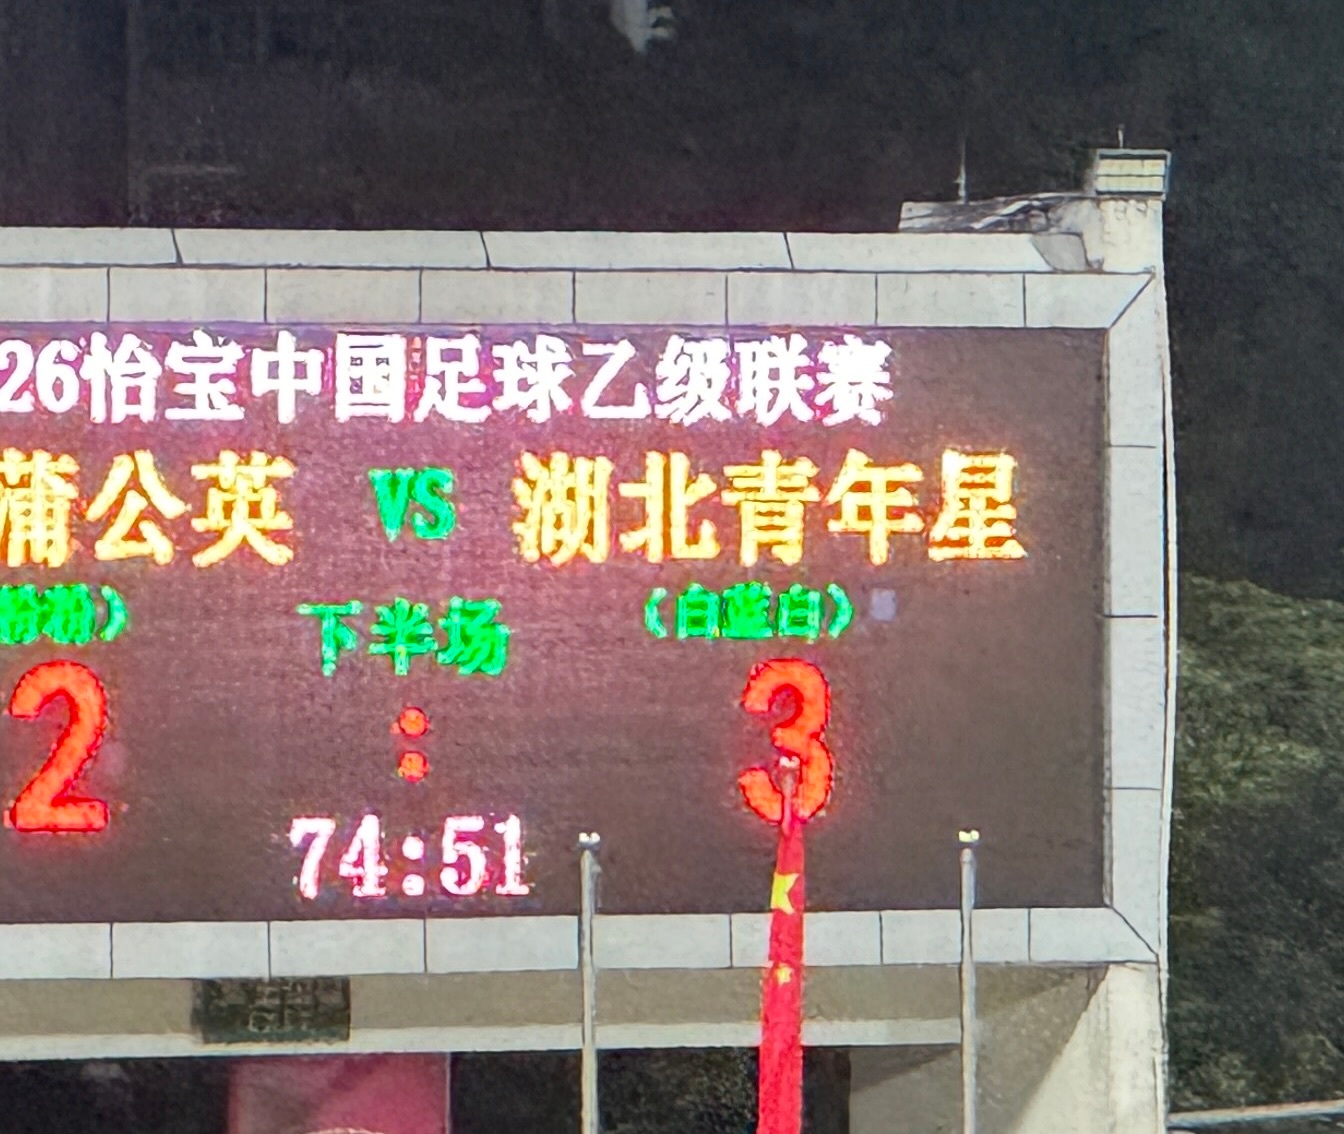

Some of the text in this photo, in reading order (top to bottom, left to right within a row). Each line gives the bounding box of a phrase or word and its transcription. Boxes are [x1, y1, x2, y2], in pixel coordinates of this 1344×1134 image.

[368, 467, 455, 540] VS
[510, 447, 1029, 566] 湖北青年星
[296, 596, 509, 676] 下半场
[5, 660, 109, 833] 2
[737, 658, 834, 826] 3
[288, 814, 529, 899] 74:51
